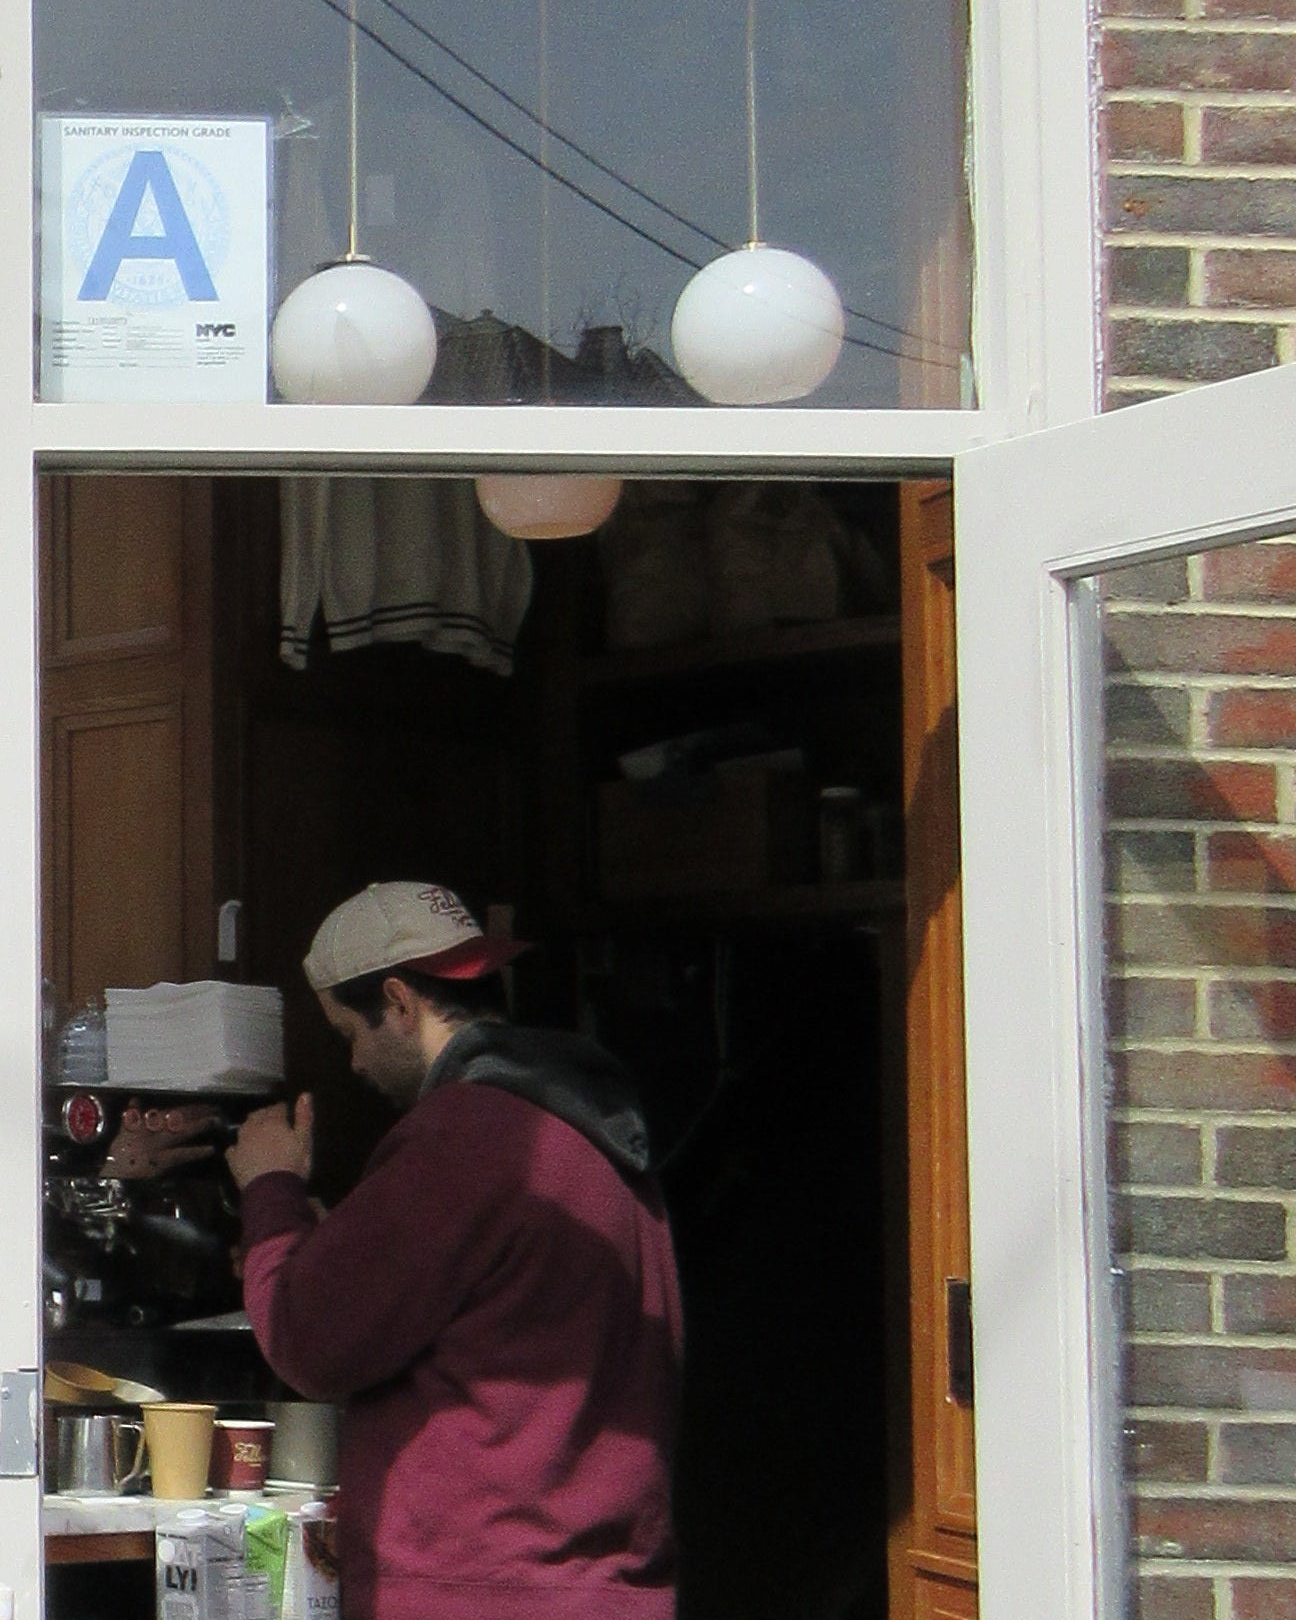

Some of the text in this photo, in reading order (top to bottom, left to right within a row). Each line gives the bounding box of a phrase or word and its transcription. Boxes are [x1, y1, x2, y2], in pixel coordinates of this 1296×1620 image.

[64, 125, 232, 138] SANITARY INSPECTION GRADE
[76, 149, 220, 301] A
[195, 323, 236, 338] NYC
